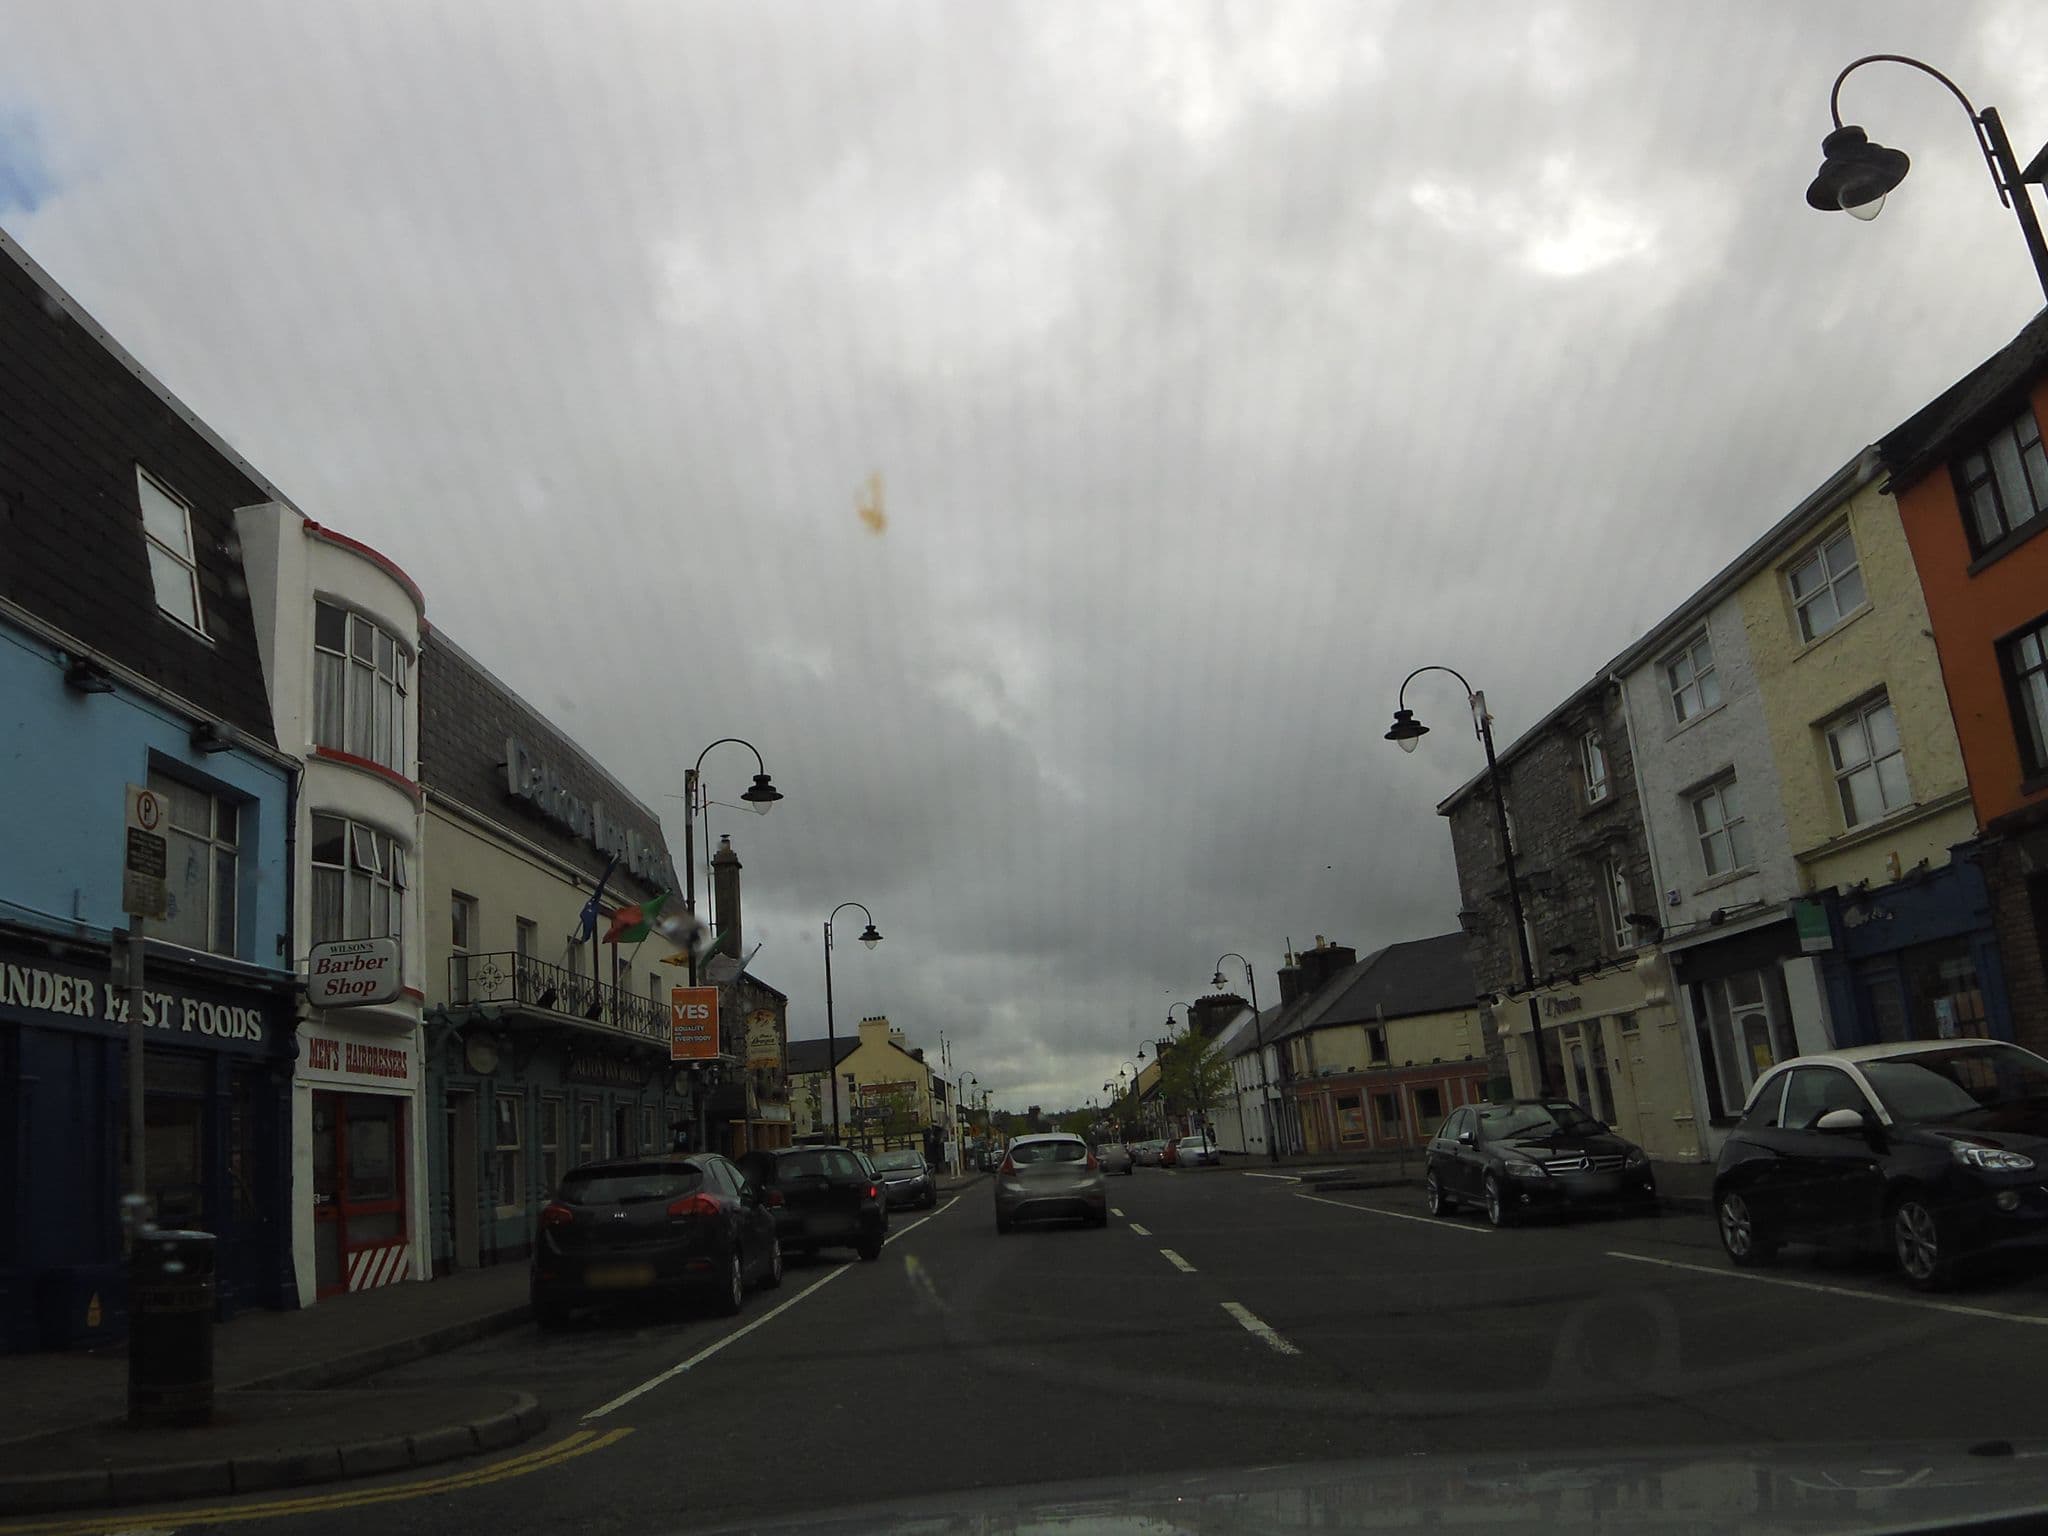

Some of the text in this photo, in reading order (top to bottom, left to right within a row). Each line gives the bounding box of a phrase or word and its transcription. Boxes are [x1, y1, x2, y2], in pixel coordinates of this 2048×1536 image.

[330, 943, 374, 953] WILSON'S
[314, 955, 389, 975] Barber
[324, 978, 377, 997] Shop
[181, 997, 262, 1042] FOODS
[674, 1004, 710, 1020] YES
[309, 1038, 408, 1079] MEN'S HAIRDRESSERS
